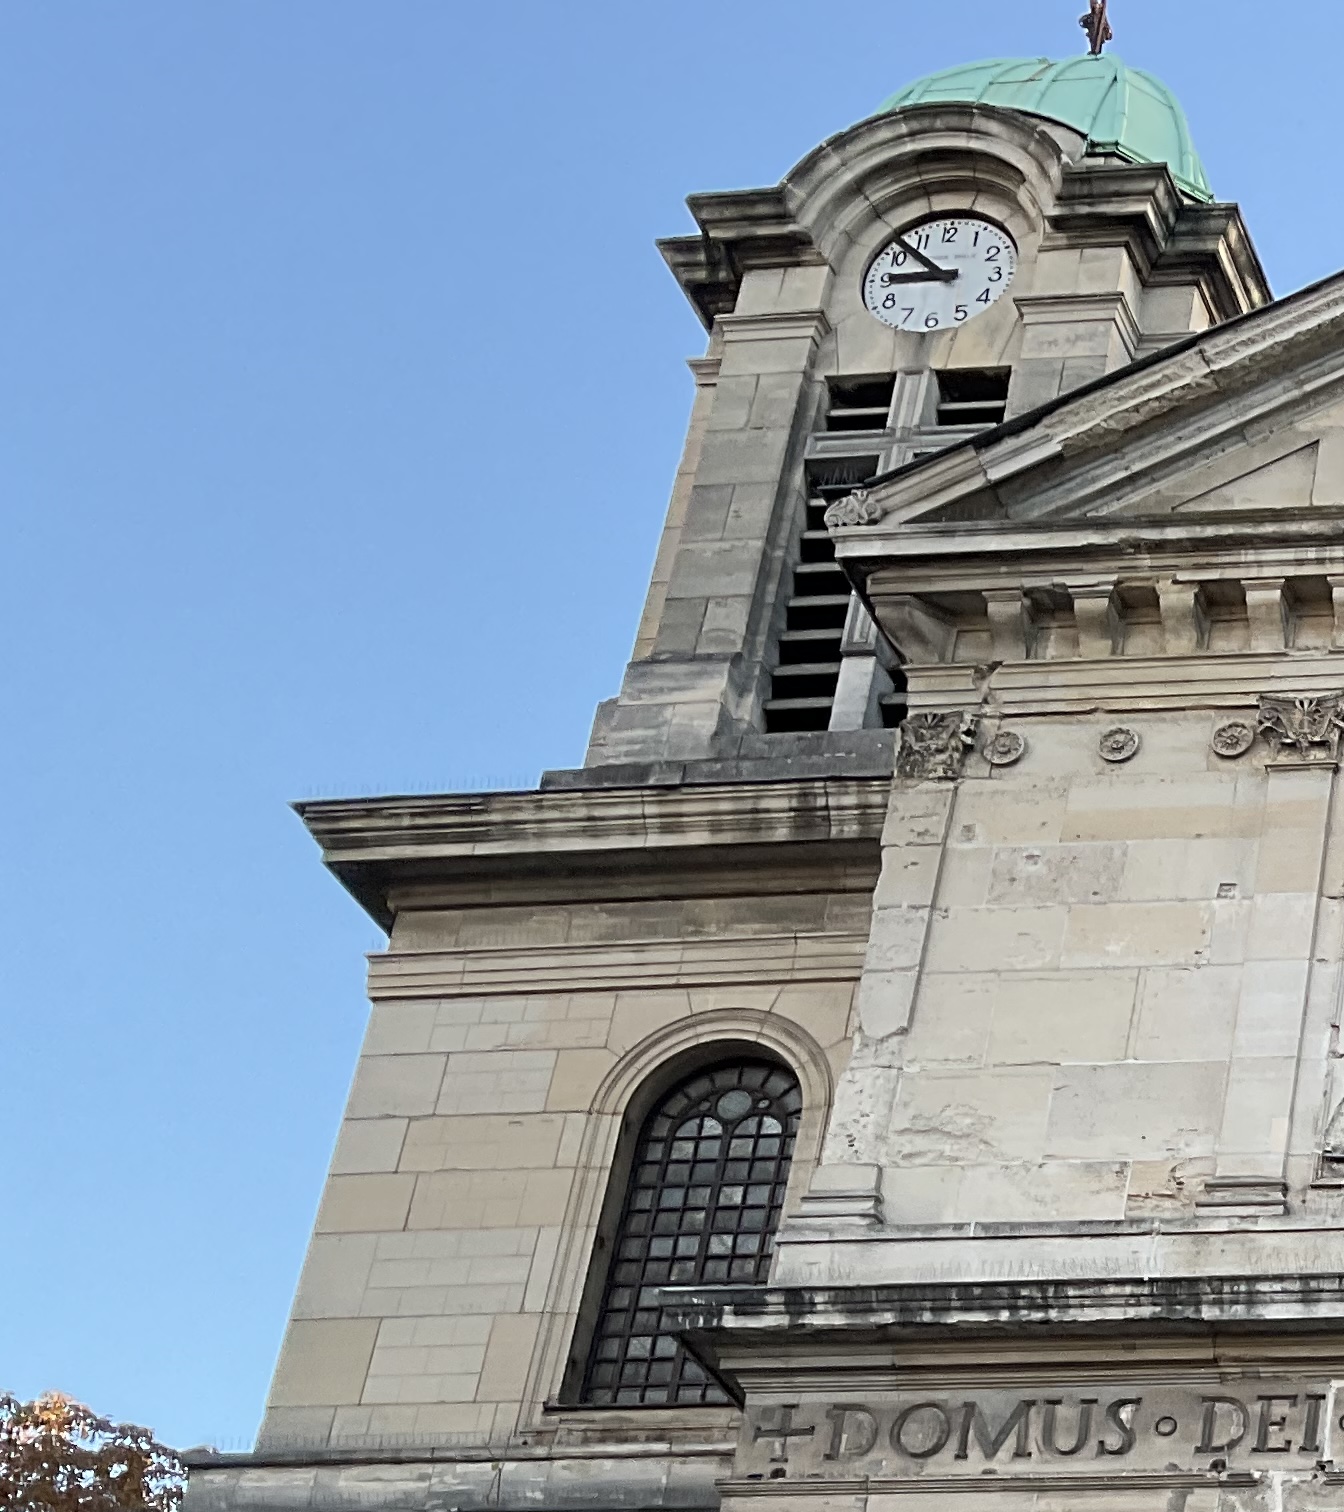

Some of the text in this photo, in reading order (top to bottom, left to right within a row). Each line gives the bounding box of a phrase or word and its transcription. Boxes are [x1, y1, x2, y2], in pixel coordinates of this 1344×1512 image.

[916, 234, 930, 250] 11
[942, 227, 958, 243] 12
[972, 230, 980, 247] 1
[890, 250, 907, 267] 10
[984, 246, 1000, 262] 2
[880, 273, 892, 288] 9
[988, 266, 1002, 282] 3
[882, 293, 896, 309] 8
[976, 288, 990, 304] 4
[901, 308, 914, 324] 7
[924, 312, 938, 328] 6
[954, 304, 968, 322] 5
[823, 1397, 1142, 1461] DOMUS
[1193, 1394, 1327, 1455] DEI
